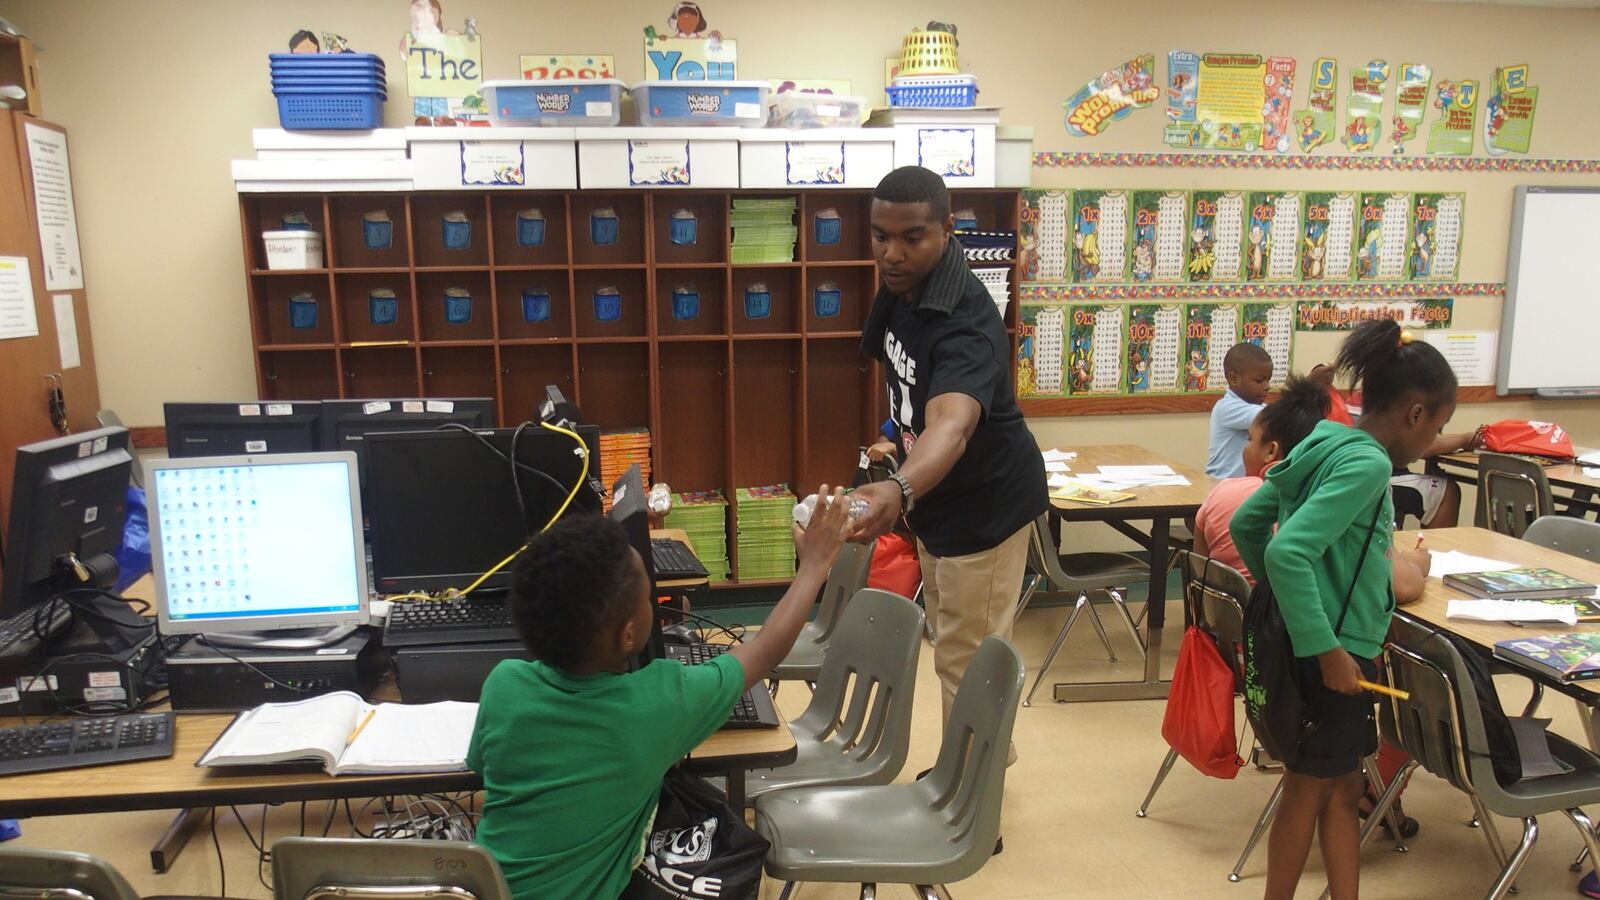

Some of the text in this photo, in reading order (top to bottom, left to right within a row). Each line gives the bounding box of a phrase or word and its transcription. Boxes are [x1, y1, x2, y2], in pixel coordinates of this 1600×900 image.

[410, 47, 478, 80] The
[647, 51, 735, 80] You
[1173, 52, 1193, 61] Extra
[1272, 62, 1291, 71] Facts
[1317, 61, 1333, 85] S
[1368, 63, 1387, 81] K
[1507, 69, 1524, 89] E
[536, 93, 570, 102] NUMBER
[687, 94, 720, 103] NUMBER
[1460, 85, 1473, 104] T
[538, 101, 570, 111] WORLDS
[689, 102, 719, 112] WORLDS
[1163, 134, 1188, 144] Asked
[1301, 305, 1449, 323] Multiplication Facts
[884, 327, 916, 385] GAGE
[651, 878, 680, 898] Community
